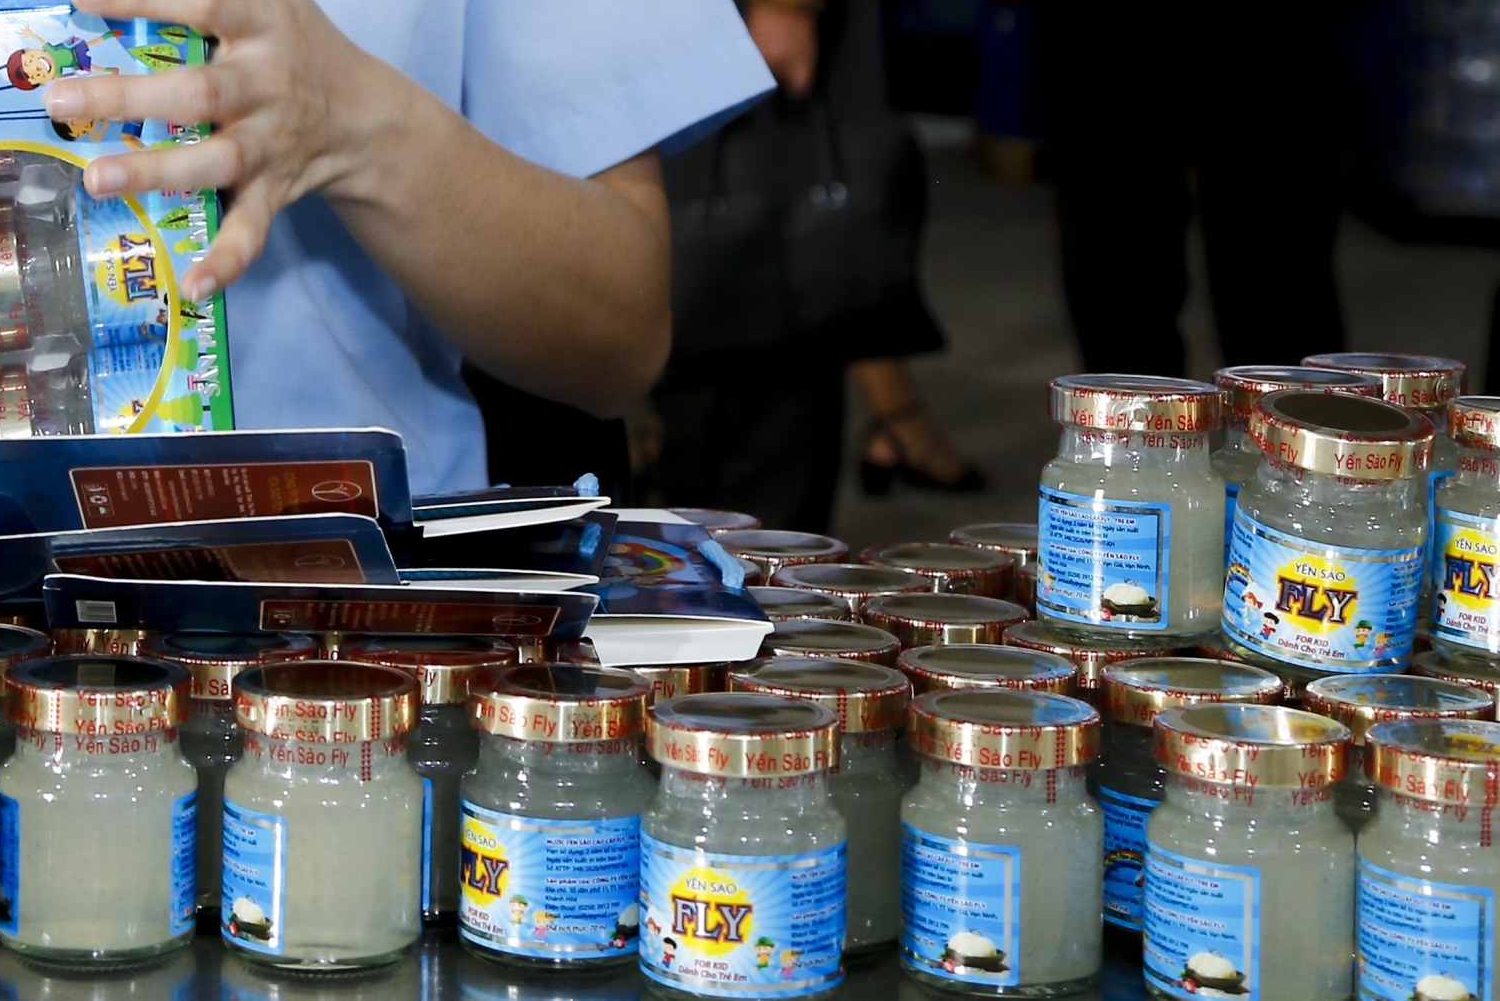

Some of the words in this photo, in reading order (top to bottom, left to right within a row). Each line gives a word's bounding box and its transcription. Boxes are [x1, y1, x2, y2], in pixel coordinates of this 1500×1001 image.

[119, 235, 159, 303] FLY
[1071, 408, 1093, 425] Yến
[1117, 413, 1134, 429] Fly
[1146, 414, 1172, 430] Yến
[1335, 452, 1360, 470] Yến
[1366, 454, 1386, 470] Sào
[1388, 453, 1403, 471] Fly
[1295, 563, 1316, 576] YẾN
[1444, 553, 1500, 600] FLY
[1275, 575, 1358, 624] FLY
[1459, 613, 1472, 621] FOR
[1473, 615, 1486, 624] KID
[1463, 623, 1476, 631] Cho
[1278, 639, 1299, 649] Dành
[1301, 645, 1316, 653] Cho
[1319, 648, 1330, 656] Trẻ
[1296, 635, 1312, 644] FOR
[1314, 639, 1329, 647] KID
[333, 701, 356, 721] Fly
[533, 715, 556, 737] Fly
[145, 735, 157, 751] Fly
[332, 749, 349, 768] Fly
[709, 748, 729, 770] Fly
[746, 752, 776, 771] Yến
[783, 754, 810, 771] Sào
[816, 750, 829, 768] Fly
[980, 748, 1012, 767] Sào
[1019, 751, 1042, 770] Fly
[1233, 769, 1258, 787] Fly
[1445, 781, 1469, 803] Fly
[468, 906, 478, 916] FOR
[479, 912, 489, 920] KID
[671, 894, 753, 944] FLY
[493, 925, 503, 933] Em
[695, 959, 711, 967] FOR
[713, 962, 728, 970] KID
[701, 970, 716, 978] Cho
